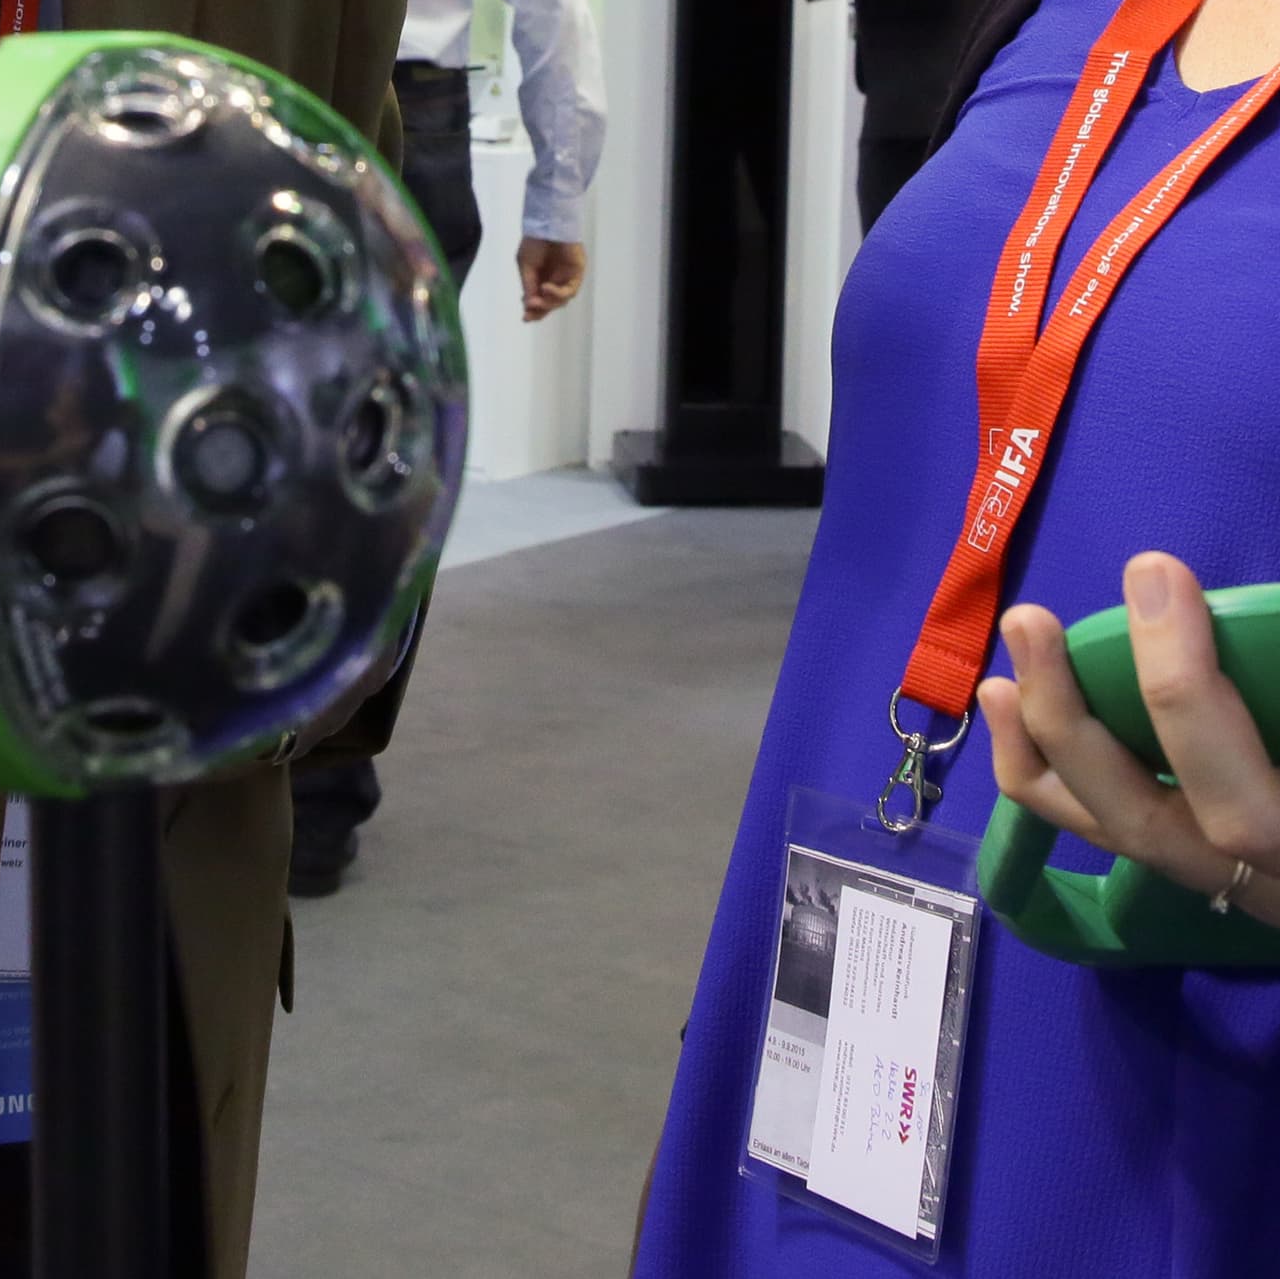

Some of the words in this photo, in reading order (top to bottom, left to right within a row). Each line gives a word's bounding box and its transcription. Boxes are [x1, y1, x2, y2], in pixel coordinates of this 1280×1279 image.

[1103, 50, 1130, 86] The
[1075, 88, 1109, 140] global
[1025, 142, 1087, 248] innovations
[1069, 278, 1099, 317] The
[1096, 216, 1145, 276] global
[1140, 116, 1240, 215] innovations
[1007, 252, 1032, 317] show.
[994, 428, 1040, 489] IFA
[898, 923, 907, 965] Andreas
[892, 968, 902, 1020] Reinhardt
